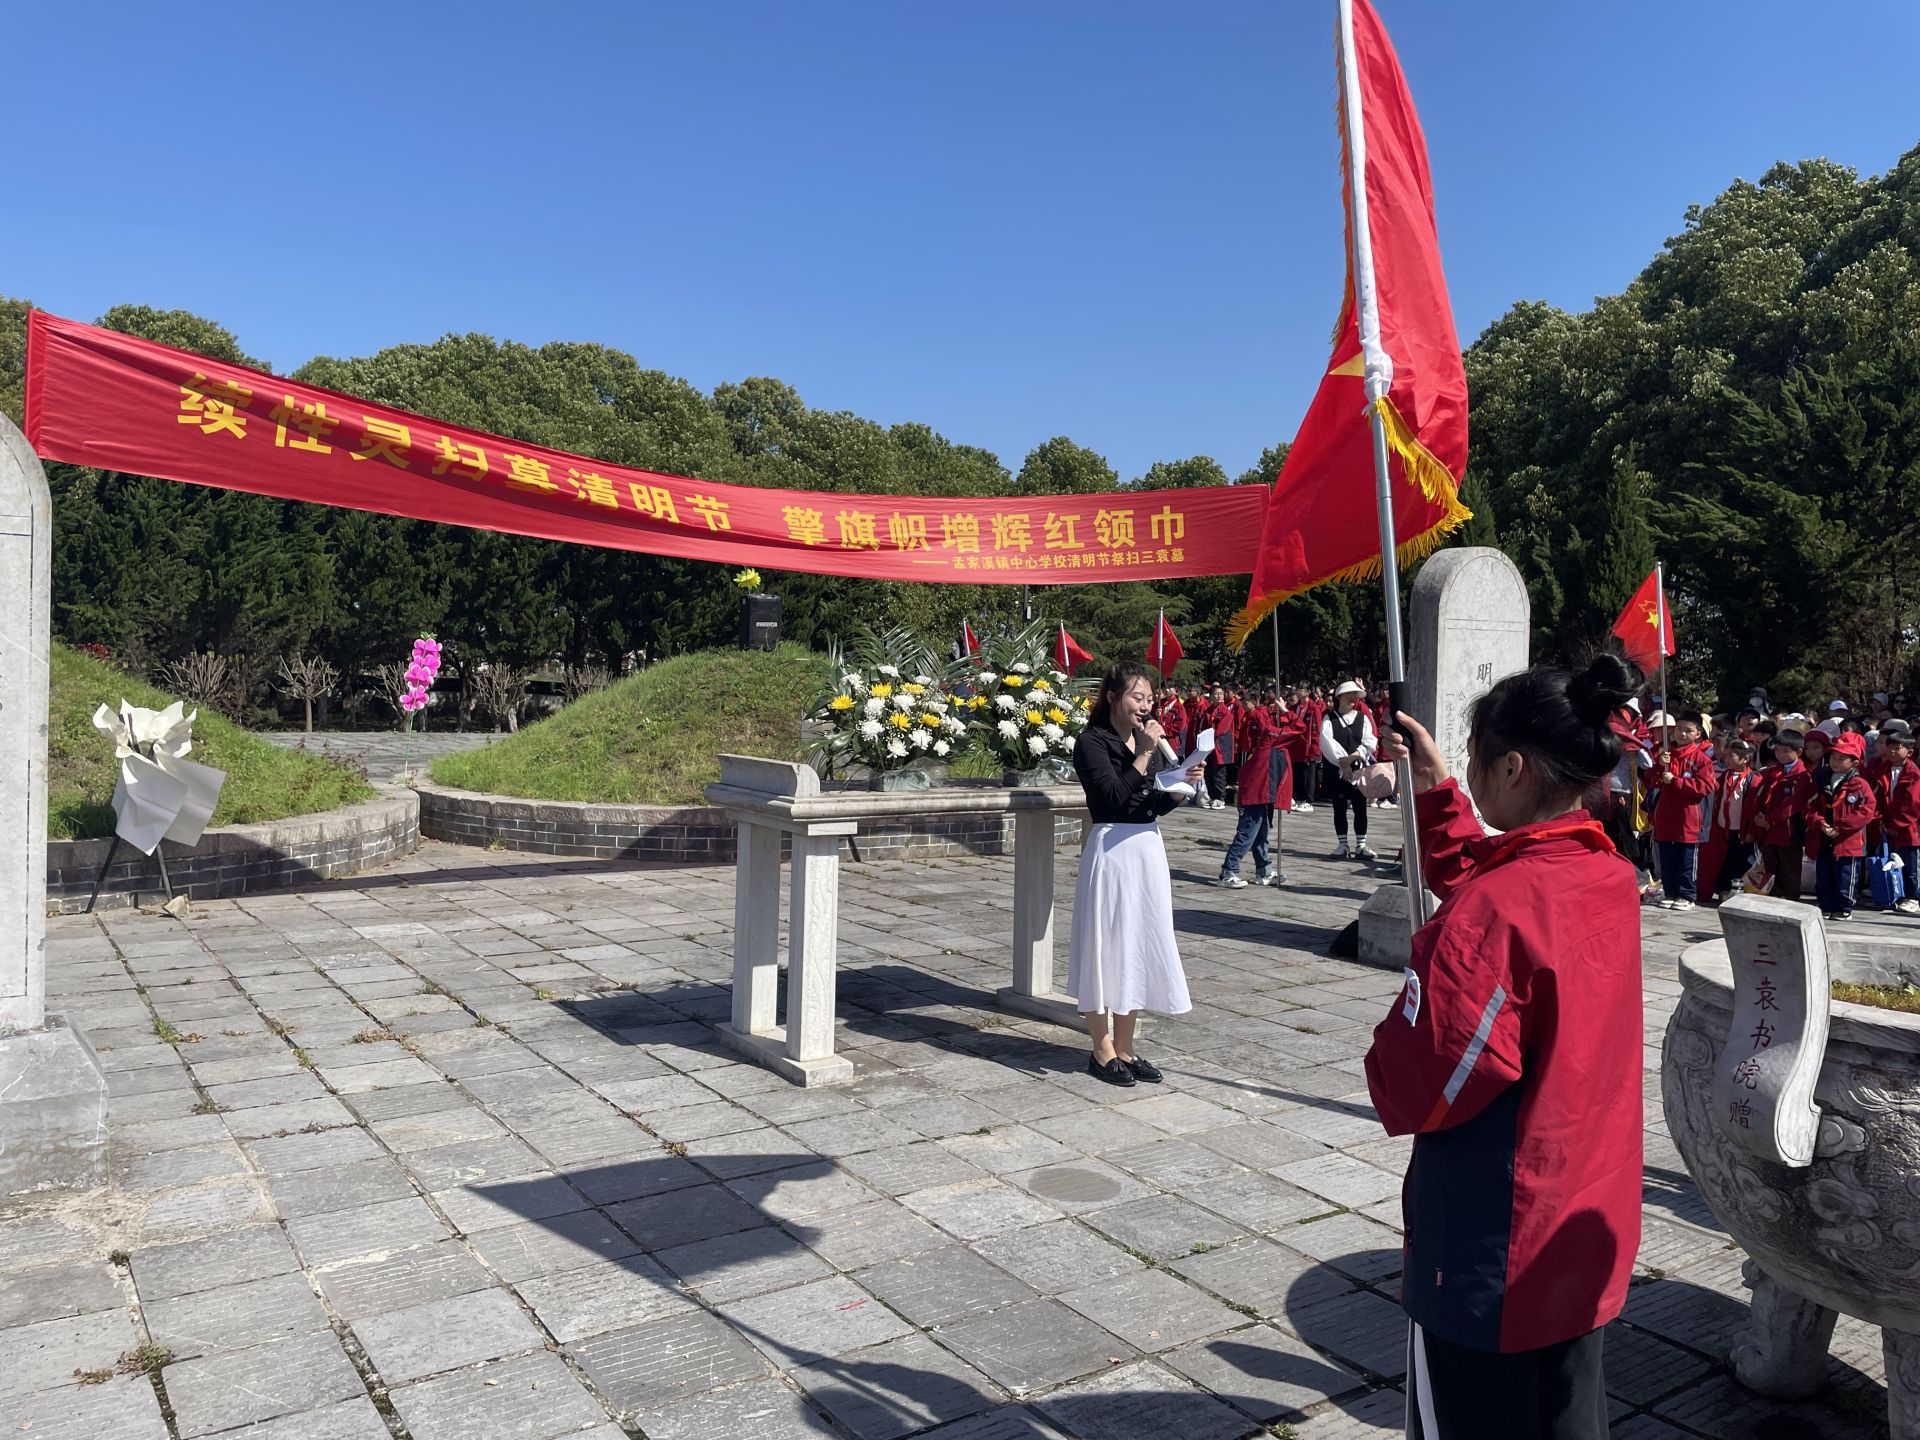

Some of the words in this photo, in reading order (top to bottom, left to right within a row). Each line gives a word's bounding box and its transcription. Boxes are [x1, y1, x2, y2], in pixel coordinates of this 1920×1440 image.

[177, 373, 732, 531] 续性灵扫墓清明节
[781, 505, 1186, 552] 擎旗帜增辉红领巾
[1476, 662, 1493, 685] 明
[1730, 944, 1781, 1129] 三袁书院赠
